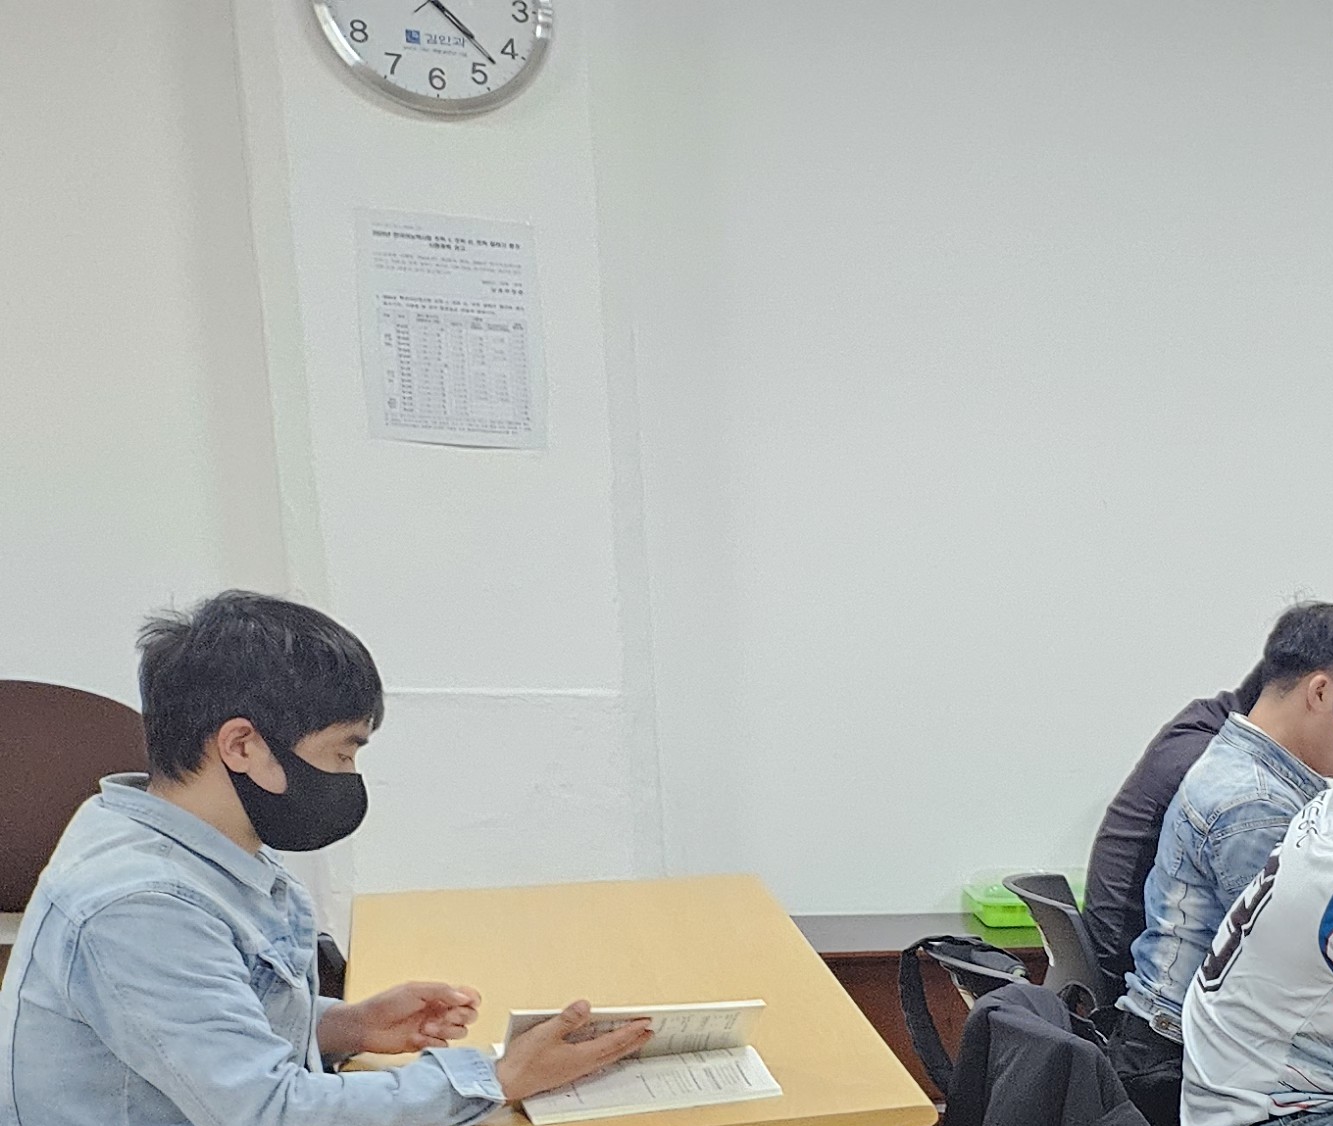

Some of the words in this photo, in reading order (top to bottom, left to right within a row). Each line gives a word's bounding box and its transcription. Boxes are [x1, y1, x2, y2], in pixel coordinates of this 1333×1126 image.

[511, 0, 530, 23] 3
[349, 19, 369, 43] 8
[500, 38, 518, 60] 4
[384, 52, 402, 75] 7
[471, 62, 489, 86] 5
[428, 67, 447, 91] 6
